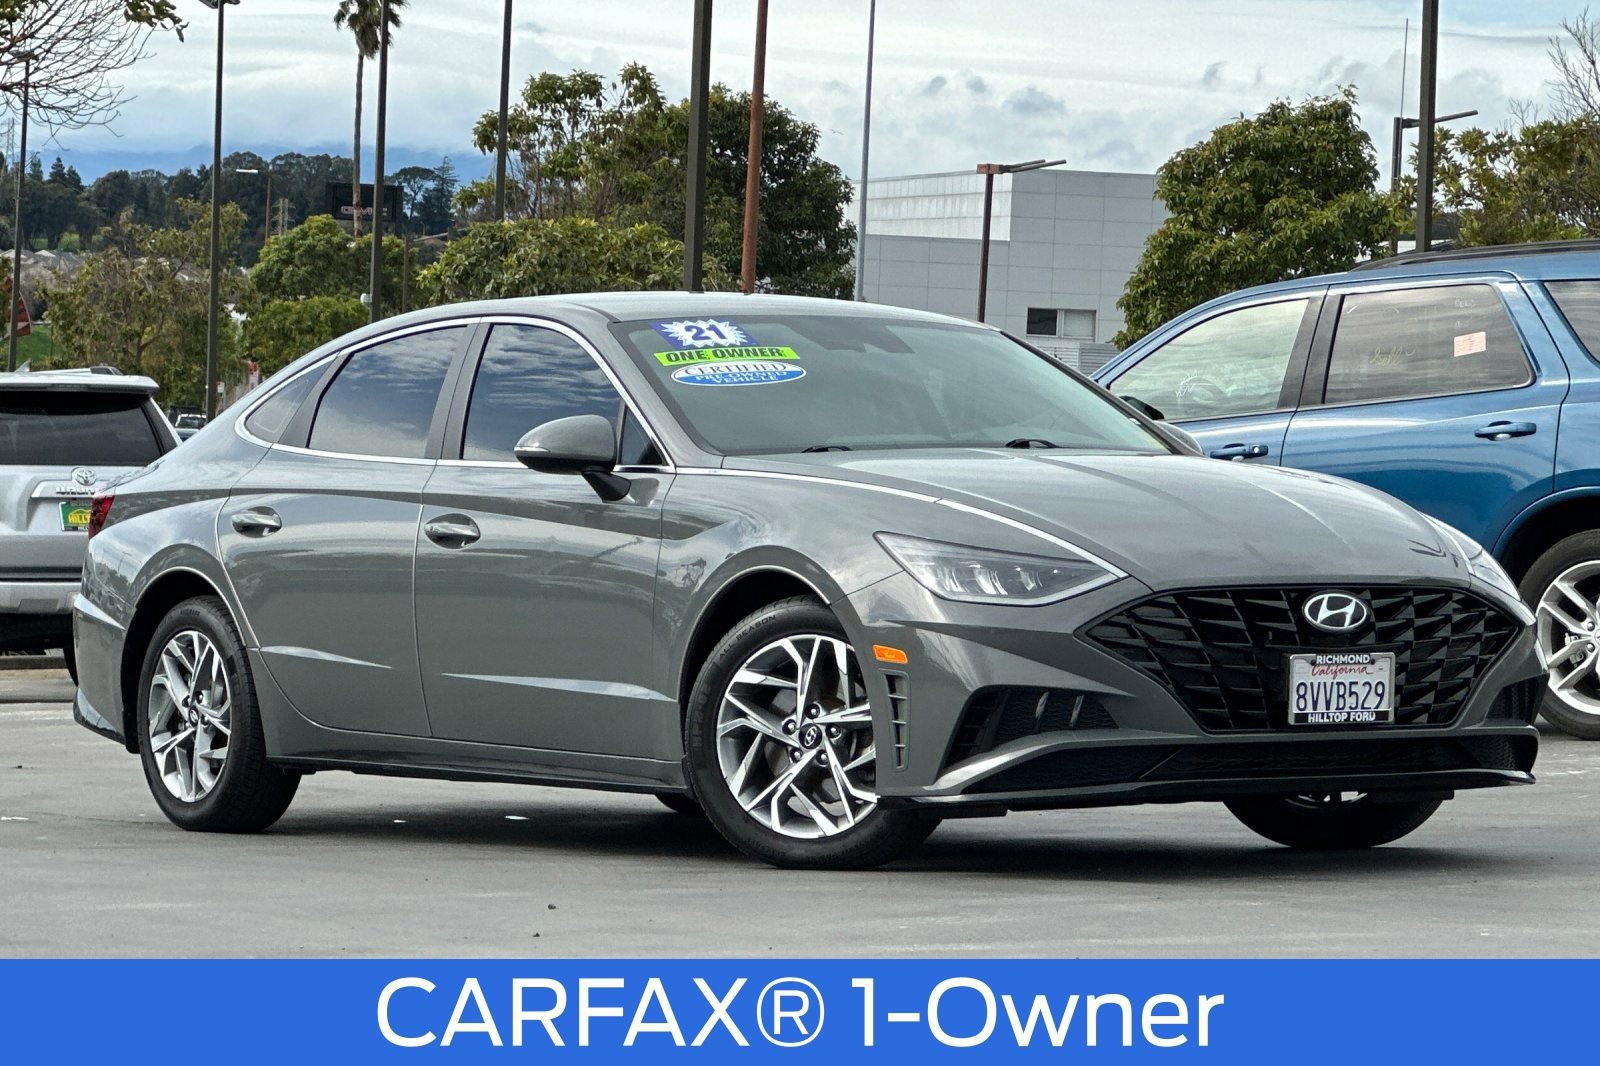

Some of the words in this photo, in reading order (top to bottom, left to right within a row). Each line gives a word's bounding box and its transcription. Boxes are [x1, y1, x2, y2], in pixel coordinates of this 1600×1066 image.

[684, 323, 728, 341] 21
[665, 350, 709, 363] ONE
[712, 347, 784, 360] OWNER
[684, 363, 787, 376] CERTIFIED
[695, 370, 788, 381] PRE-OWNED
[714, 375, 779, 384] VEHICLE
[1316, 654, 1370, 665] RICHMOND
[1311, 664, 1374, 680] California
[1296, 680, 1386, 712] 8VVB529
[1308, 712, 1348, 723] HILLTOP
[1350, 712, 1376, 722] FORD
